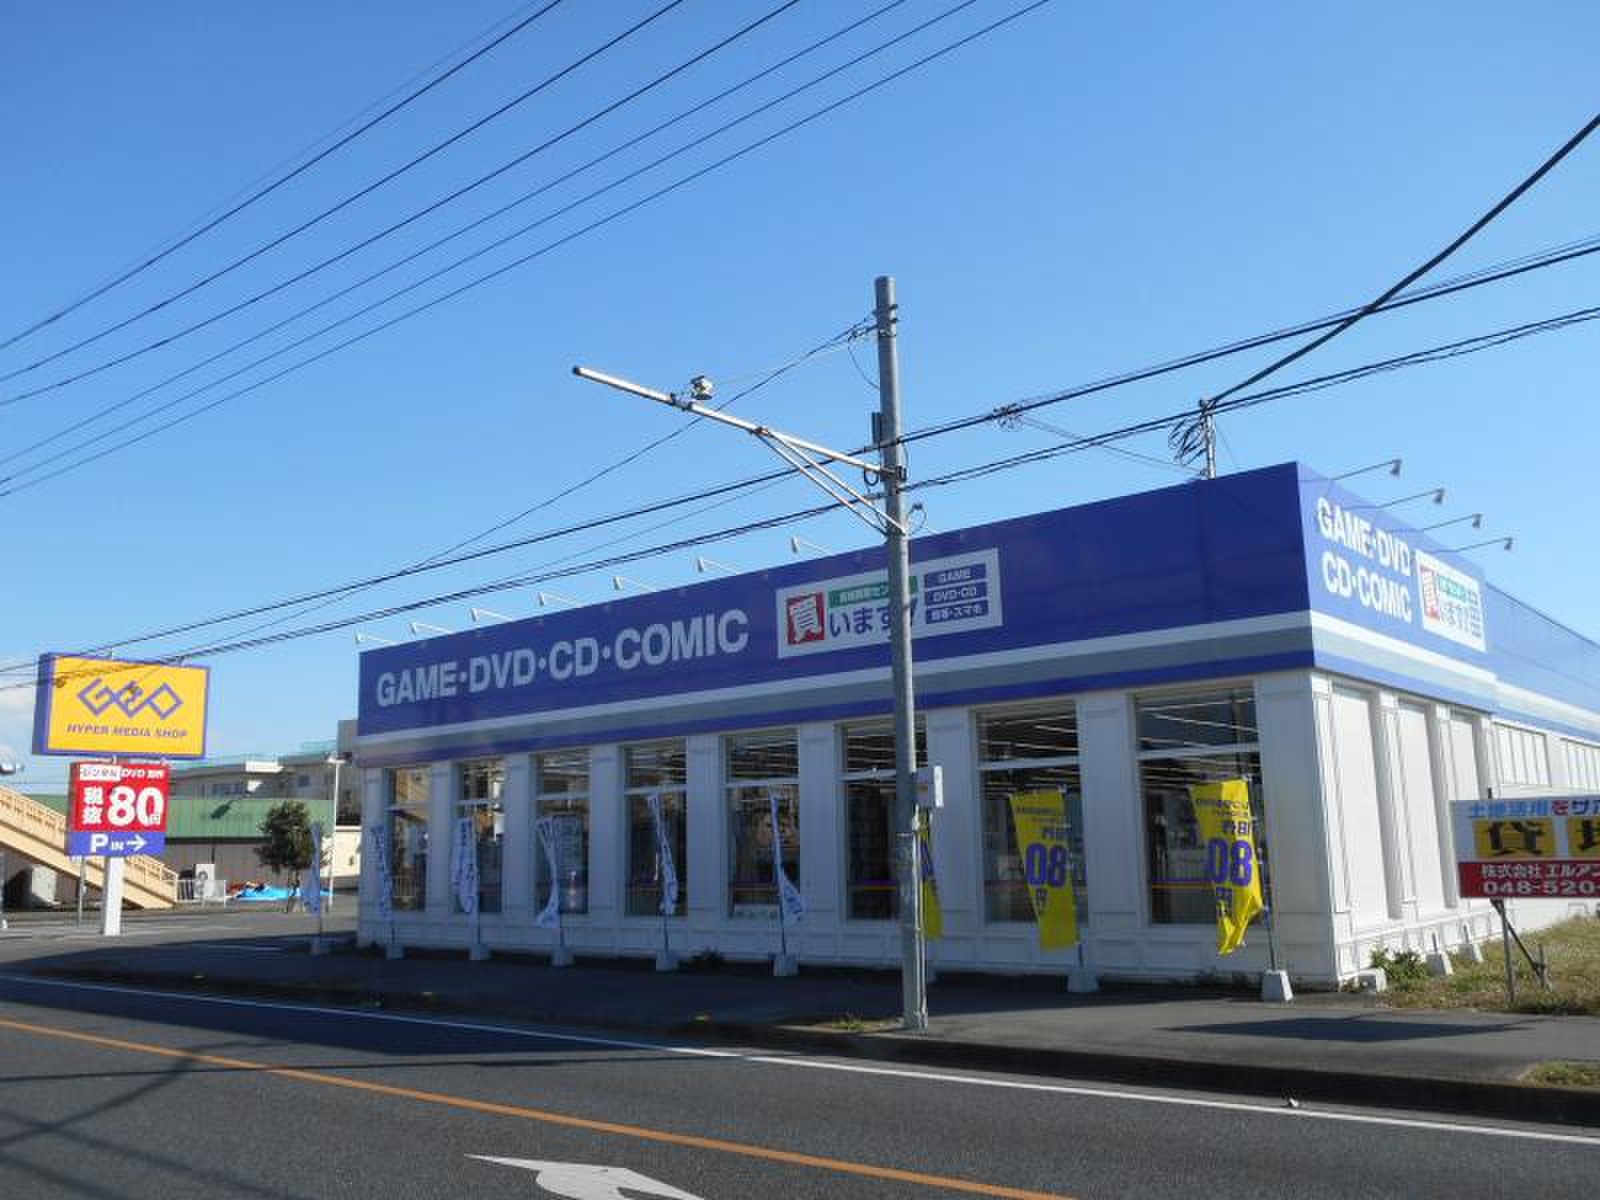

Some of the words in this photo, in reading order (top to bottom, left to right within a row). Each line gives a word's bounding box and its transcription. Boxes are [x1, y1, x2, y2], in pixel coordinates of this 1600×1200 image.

[66, 723, 109, 736] HYPER
[111, 725, 151, 737] MEDIA
[155, 727, 188, 739] SHOP
[90, 832, 109, 853] P
